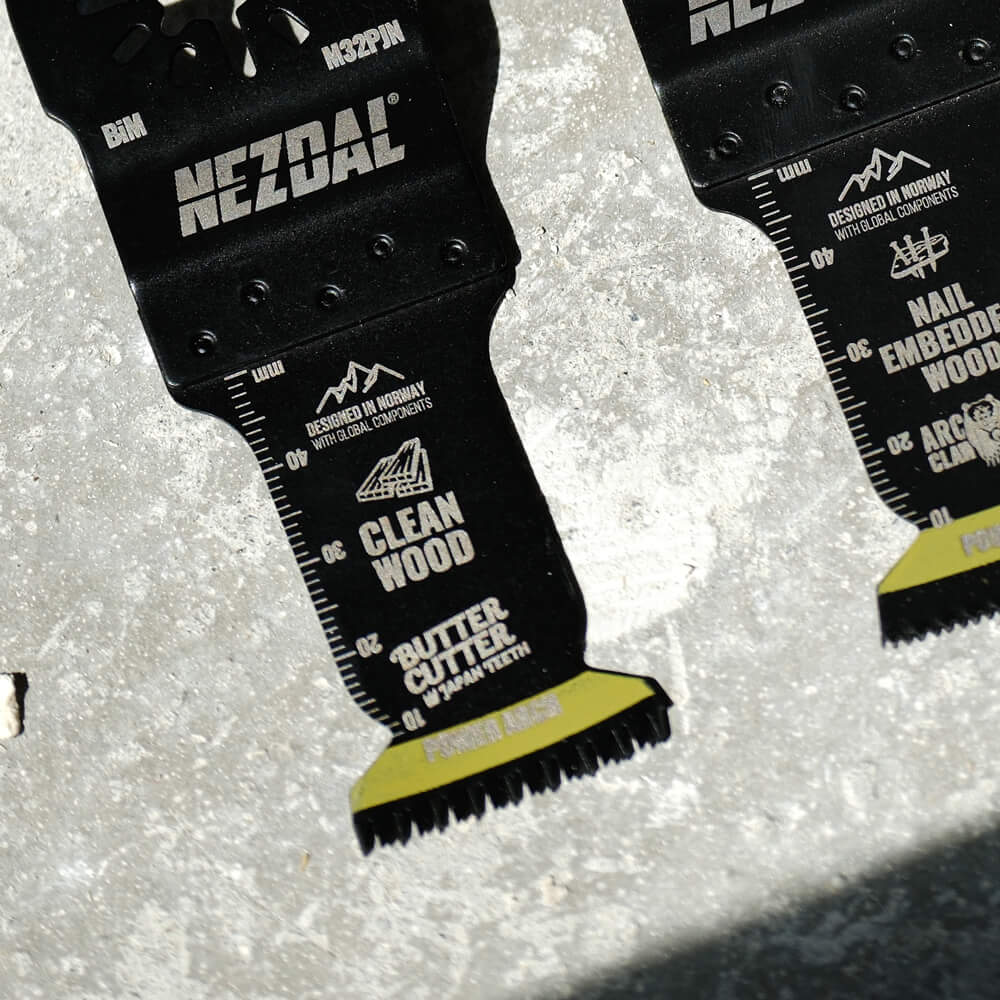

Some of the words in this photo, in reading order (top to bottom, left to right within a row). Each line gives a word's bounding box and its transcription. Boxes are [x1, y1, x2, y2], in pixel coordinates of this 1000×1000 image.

[321, 20, 406, 71] M32PJN
[101, 112, 148, 149] BiM
[828, 195, 887, 228] DESIGNED
[886, 188, 902, 207] IN
[900, 169, 951, 200] NORWAY
[833, 221, 861, 242] WITH
[860, 211, 898, 232] GLOBAL
[897, 186, 959, 219] COMPONENTS
[906, 282, 975, 329] NAIL
[305, 404, 363, 438] DESIGNED
[362, 399, 378, 417] IN
[376, 380, 427, 412] NORWAY
[311, 430, 339, 451] WITH
[337, 421, 374, 442] GLOBAL
[373, 397, 433, 429] COMPONENTS
[358, 491, 465, 557] CLEAN
[372, 528, 476, 593] WOOD
[389, 597, 510, 671] BUTTER
[404, 622, 517, 695] CUTTER
